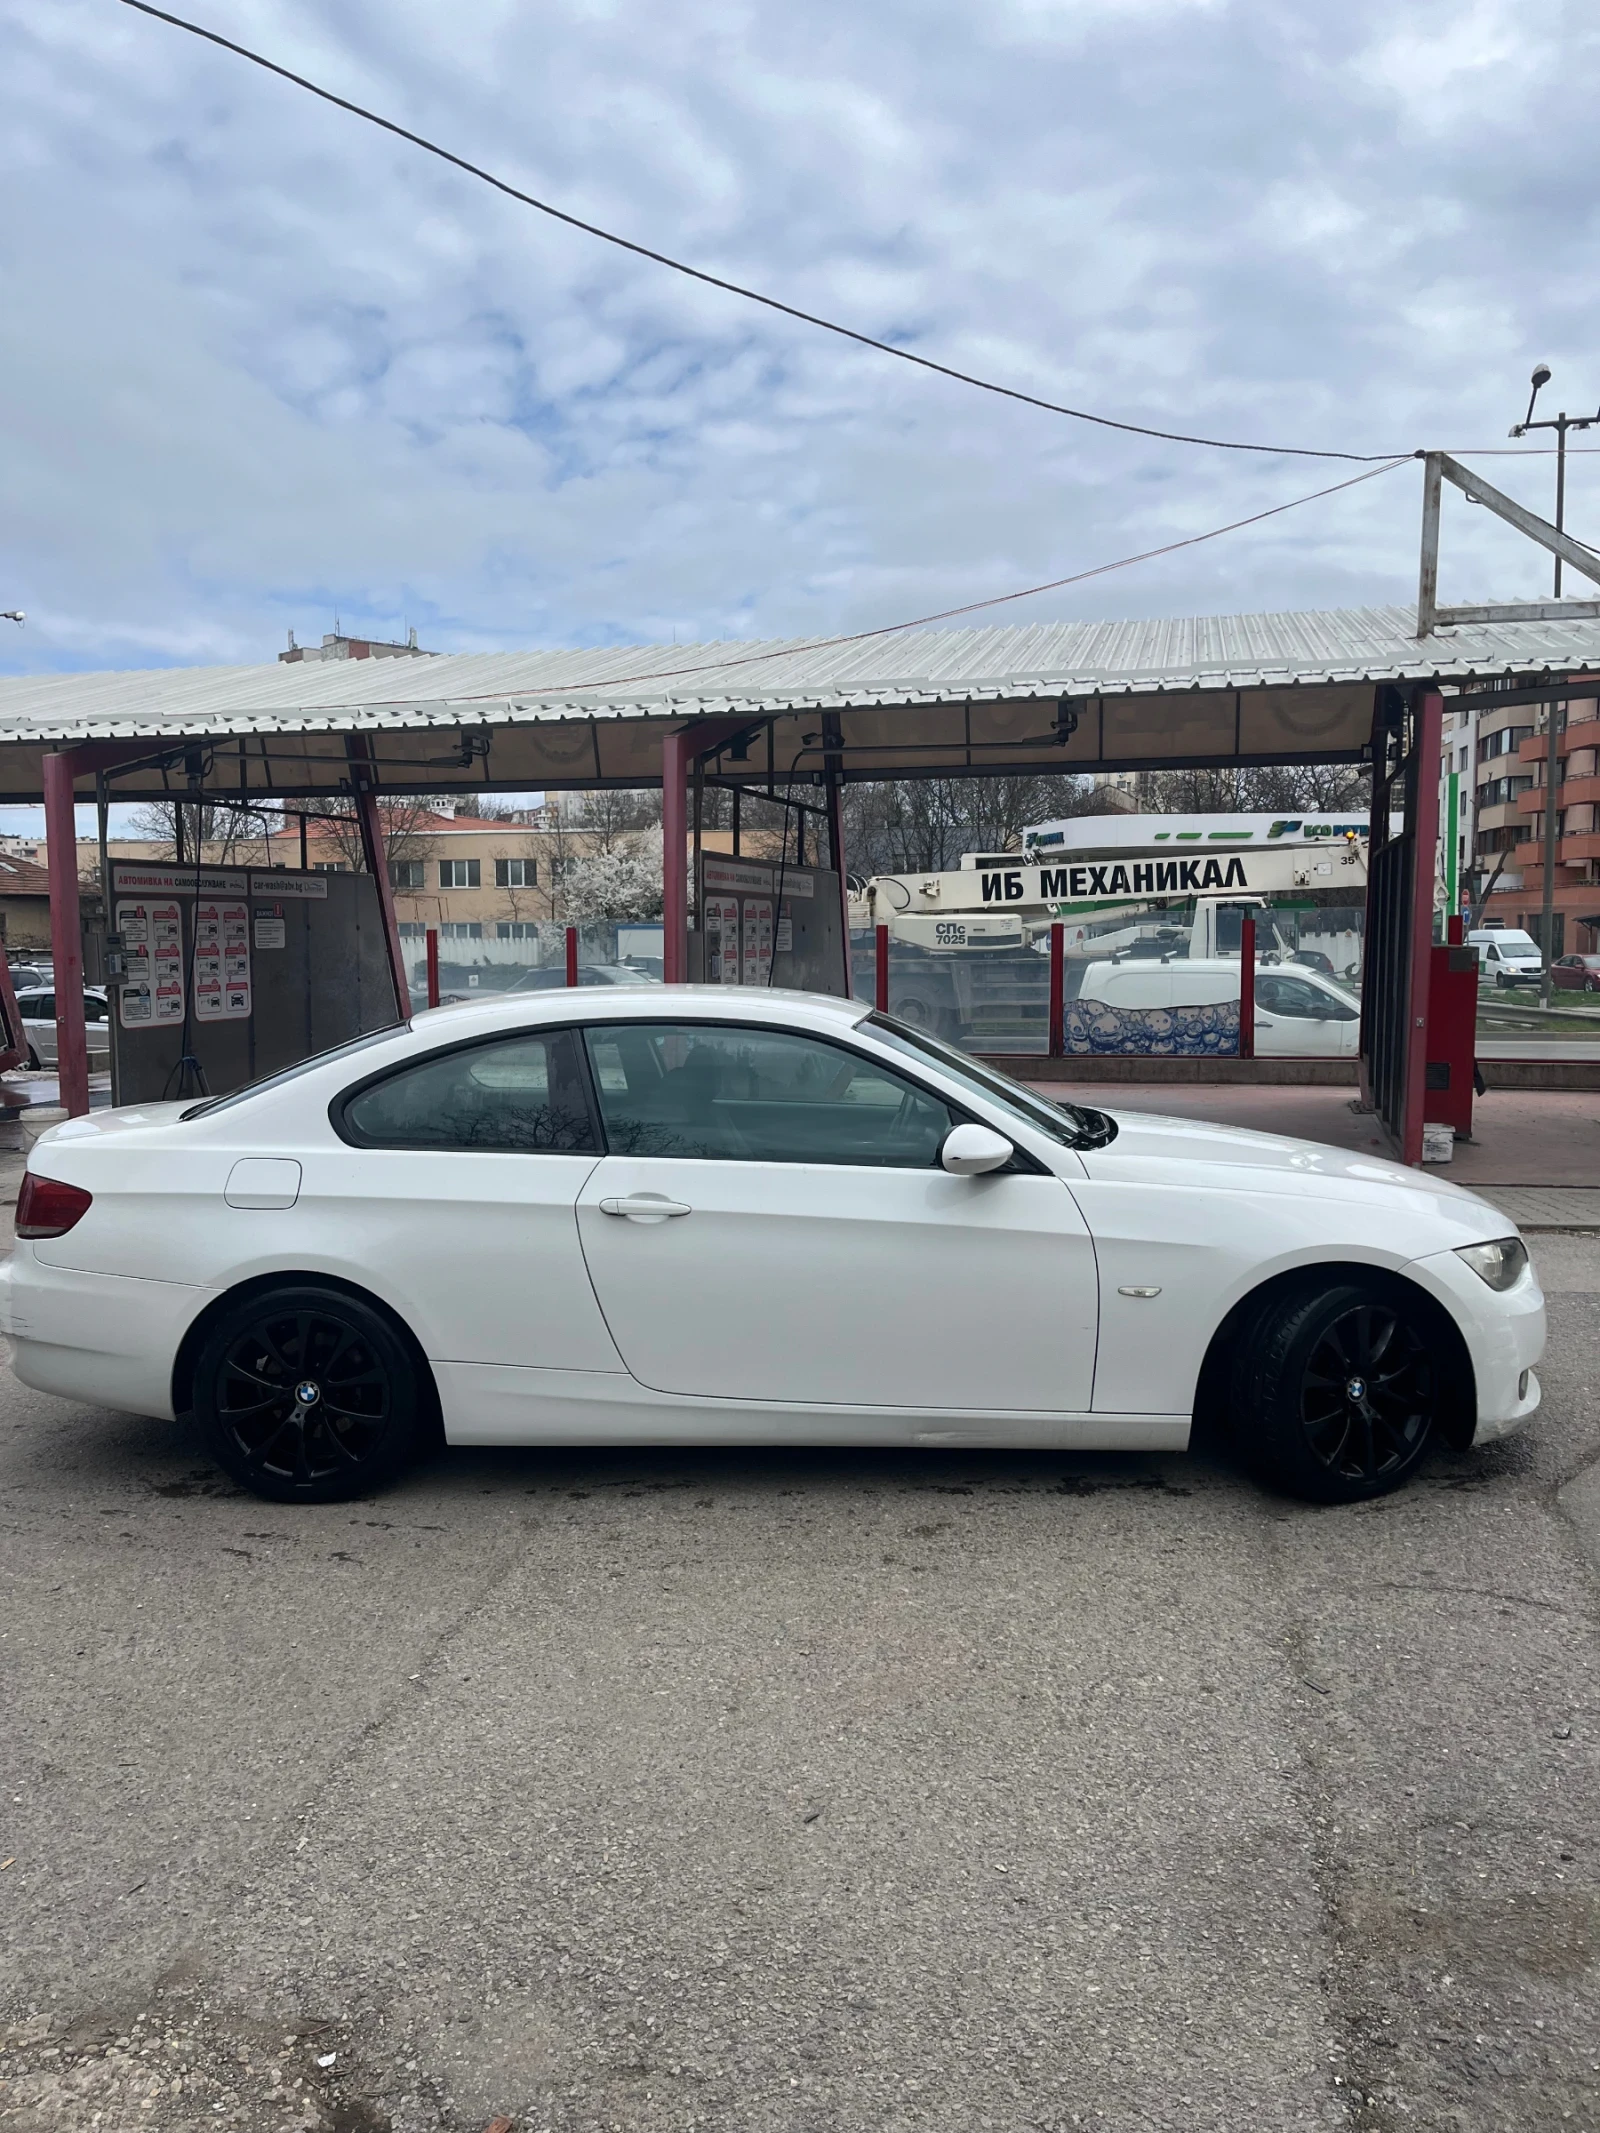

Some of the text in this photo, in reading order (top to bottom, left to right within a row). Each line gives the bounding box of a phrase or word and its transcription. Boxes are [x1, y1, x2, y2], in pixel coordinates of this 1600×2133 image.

[118, 875, 162, 886] АВТОМИВКА
[164, 877, 173, 887] НА
[981, 858, 1248, 901] ИБ МЕХАНИКАЛ
[253, 880, 303, 893] car-wash@abv.bg
[935, 934, 966, 945] 7025
